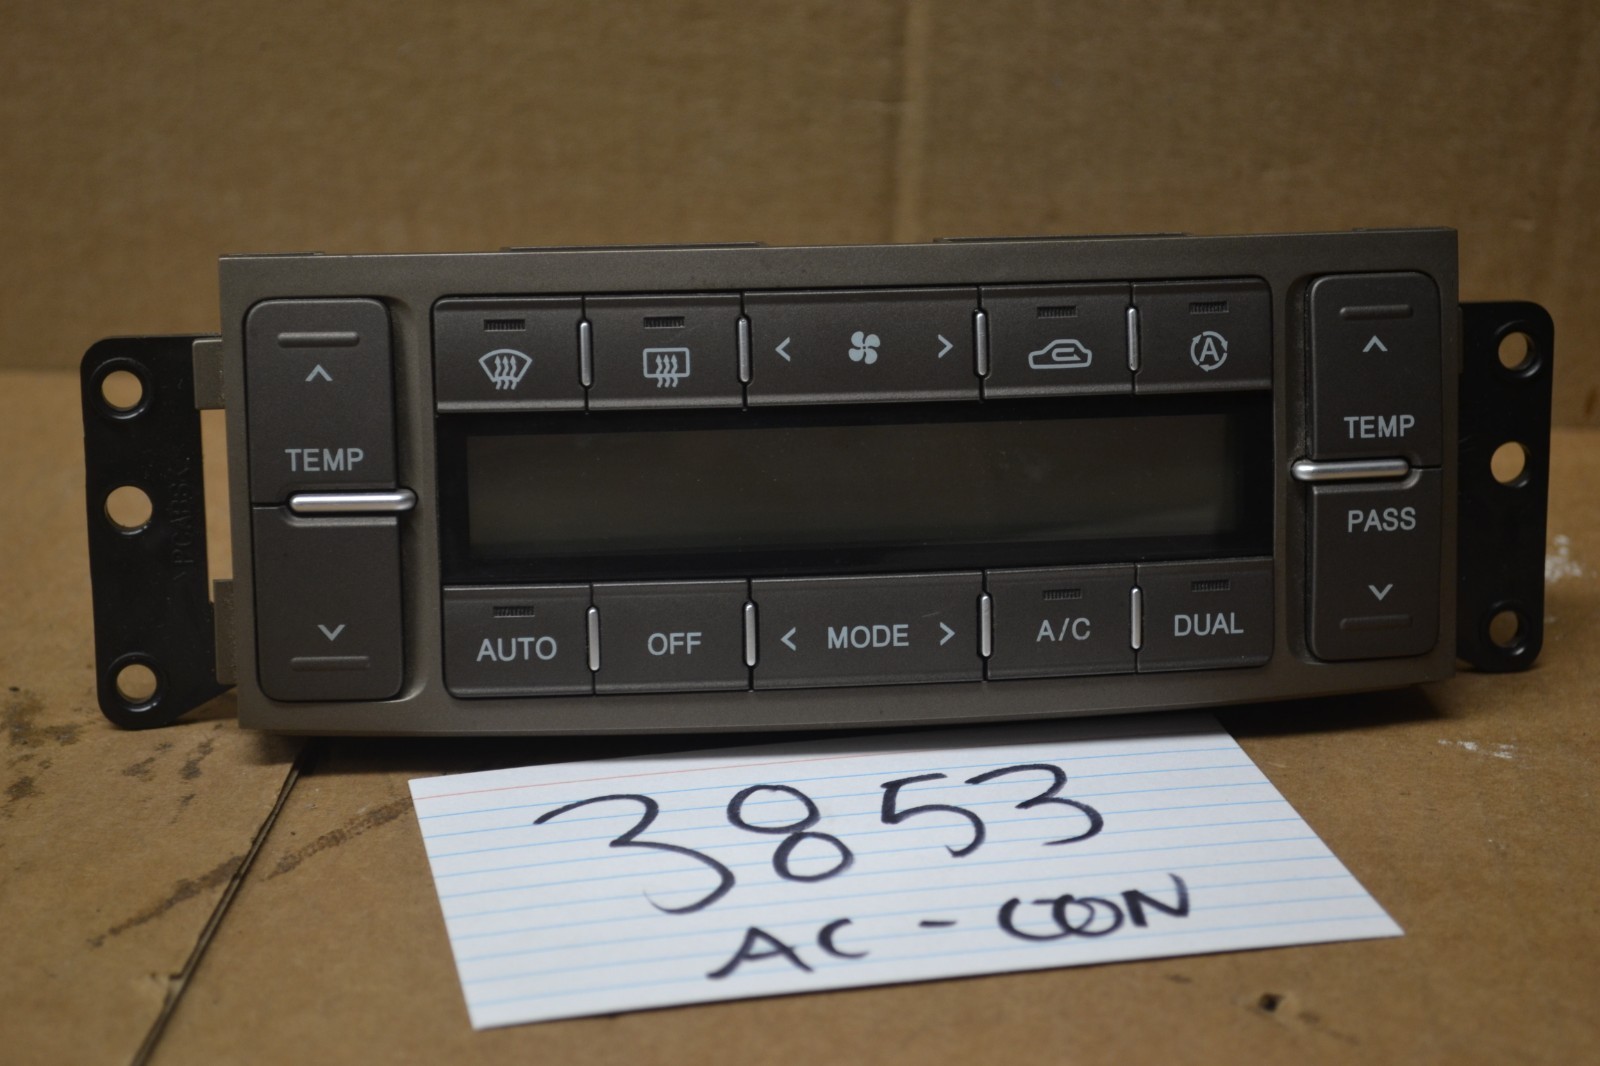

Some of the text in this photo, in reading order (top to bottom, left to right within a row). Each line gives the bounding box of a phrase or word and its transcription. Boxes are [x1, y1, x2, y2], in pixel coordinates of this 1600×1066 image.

[1344, 414, 1415, 439] TEMP
[284, 447, 364, 473] TEMP
[1347, 507, 1416, 533] PASS
[827, 623, 909, 650] MODE
[1036, 617, 1091, 642] A/C
[1174, 612, 1244, 637] DUAL
[476, 636, 557, 662] AUTO
[647, 632, 702, 655] OFF
[534, 763, 1104, 914] 3853
[706, 917, 869, 980] AC
